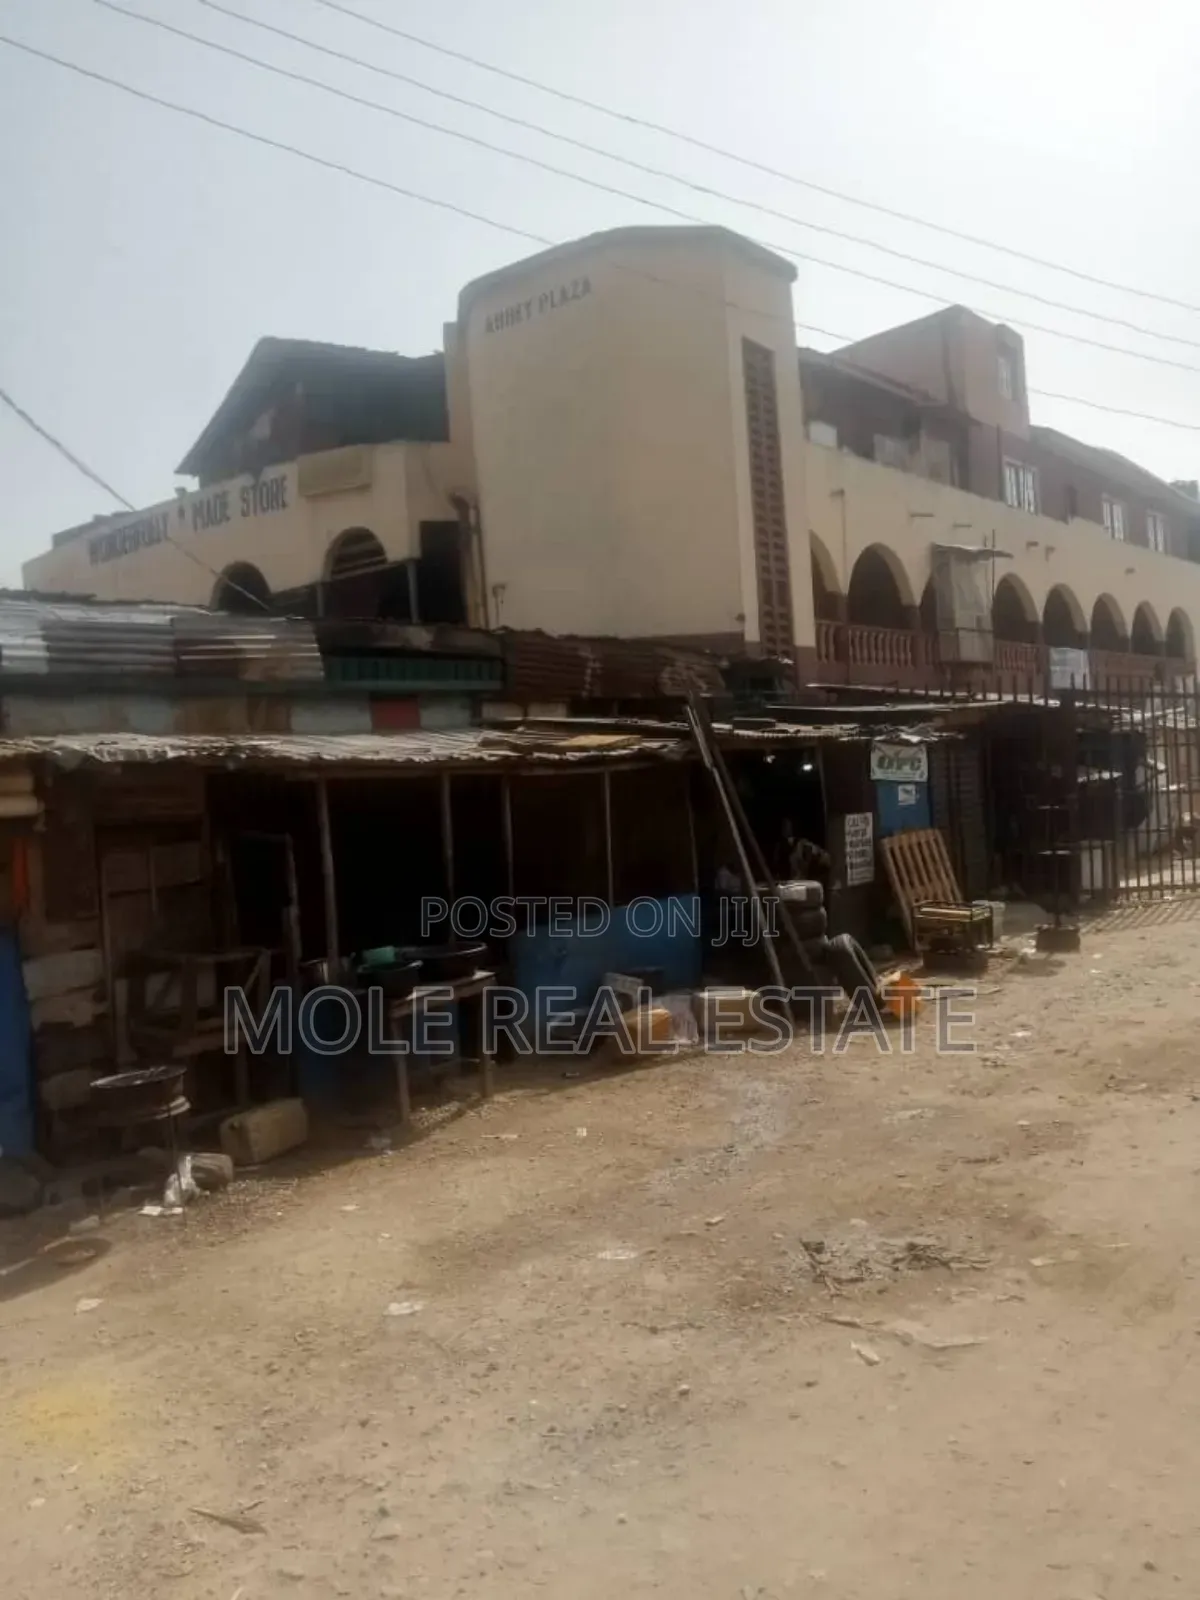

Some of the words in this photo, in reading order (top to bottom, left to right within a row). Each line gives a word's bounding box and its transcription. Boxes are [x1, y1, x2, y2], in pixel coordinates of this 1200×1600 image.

[538, 278, 592, 319] PLAZA
[192, 490, 231, 532] MADE
[240, 474, 290, 517] STORE
